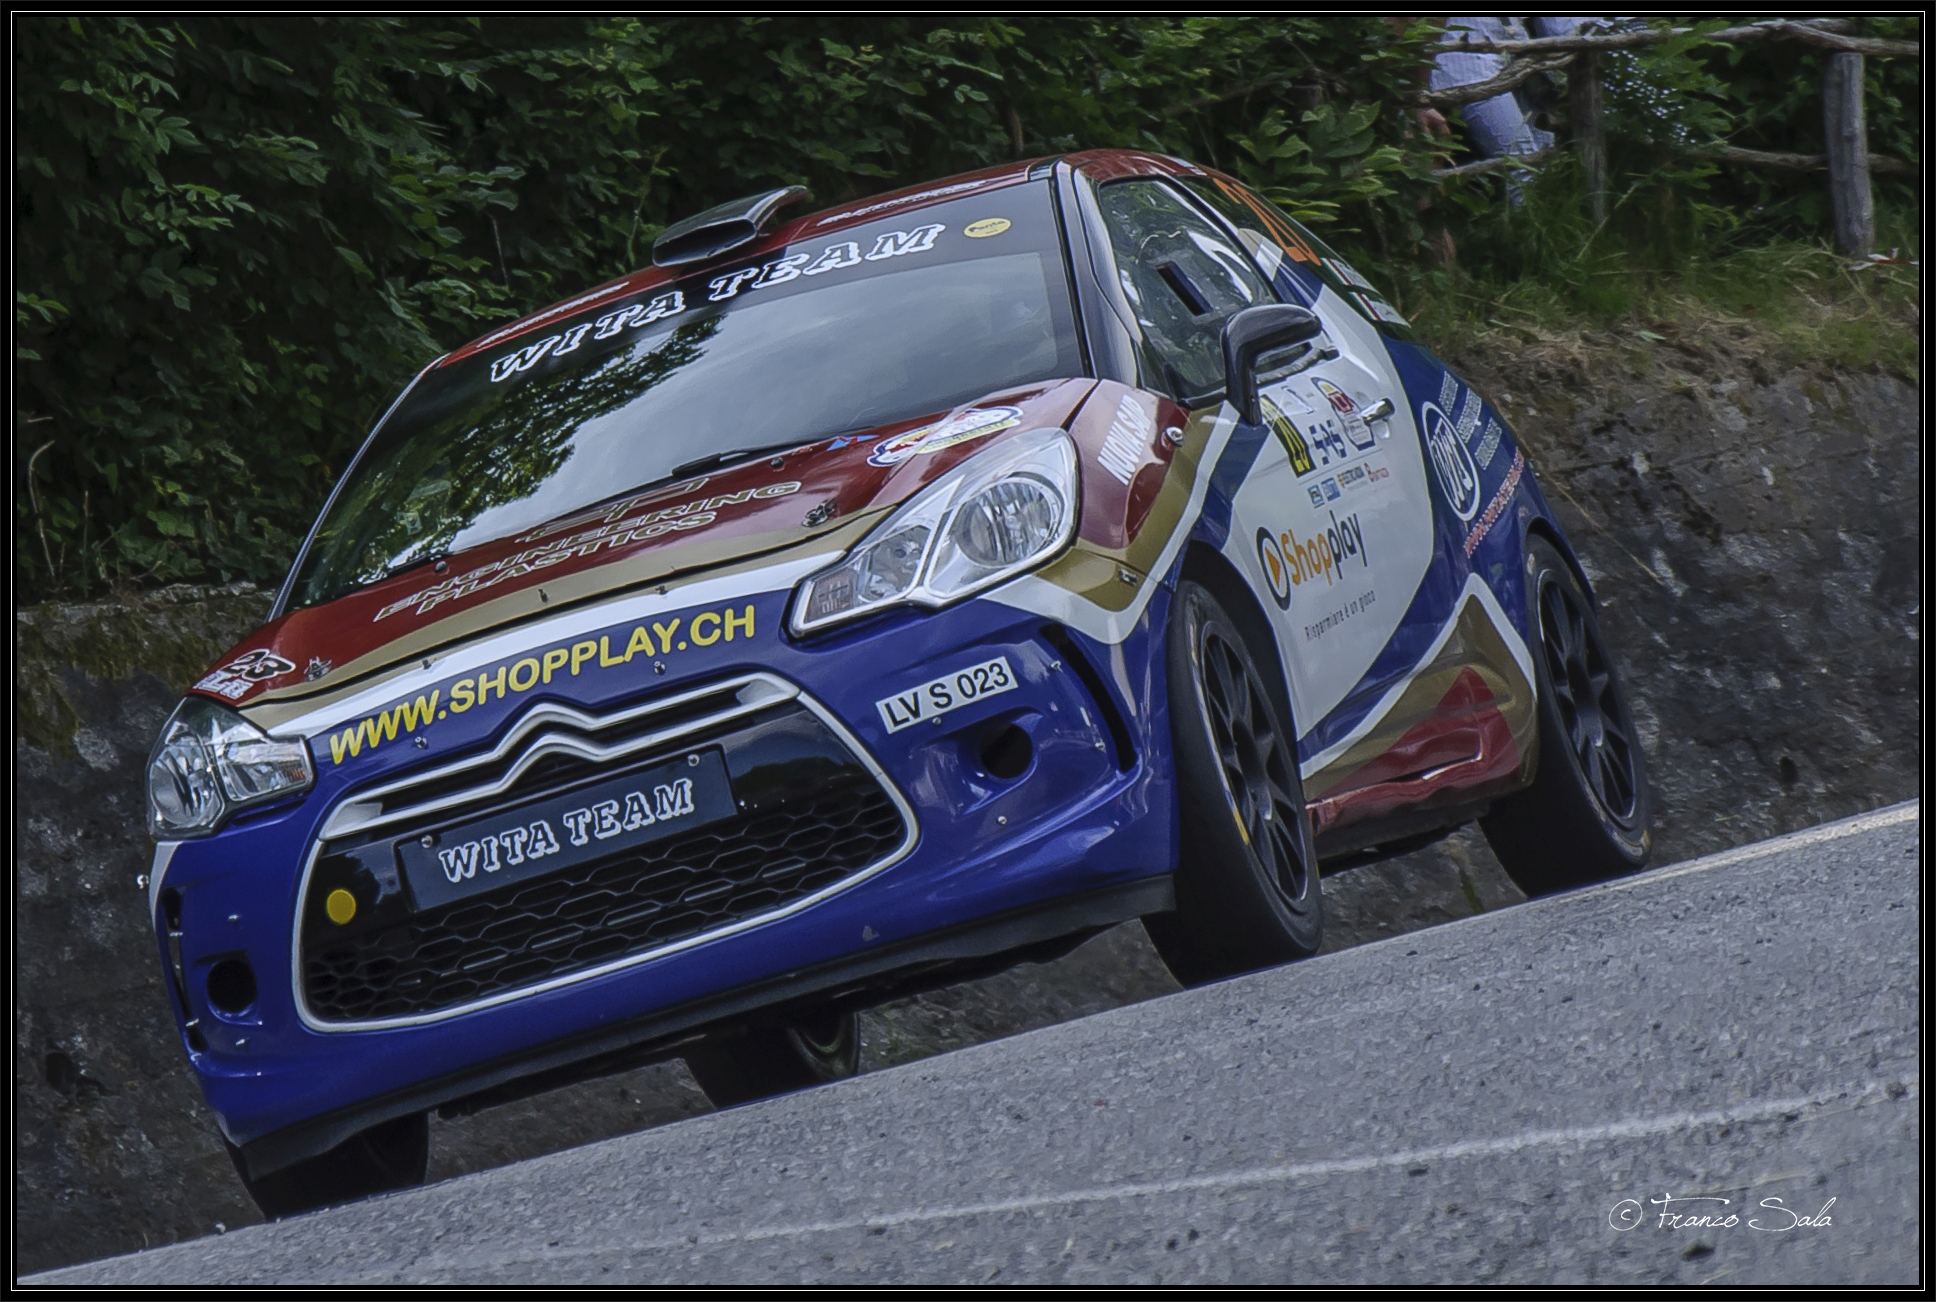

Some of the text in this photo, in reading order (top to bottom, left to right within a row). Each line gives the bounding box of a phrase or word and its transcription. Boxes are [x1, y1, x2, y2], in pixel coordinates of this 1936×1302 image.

[490, 290, 686, 383] WITA
[708, 223, 946, 301] TEAM
[1097, 394, 1151, 486] NUOVA SAIP
[372, 481, 802, 623] ENGINEERING
[415, 511, 718, 616] PLASTICS
[1281, 509, 1368, 587] Shopplay
[218, 648, 297, 682] 23
[328, 604, 756, 766] WWW.SHOPPLAY.CH
[884, 662, 1009, 728] LV S 023
[438, 777, 695, 883] WITA TEAM
